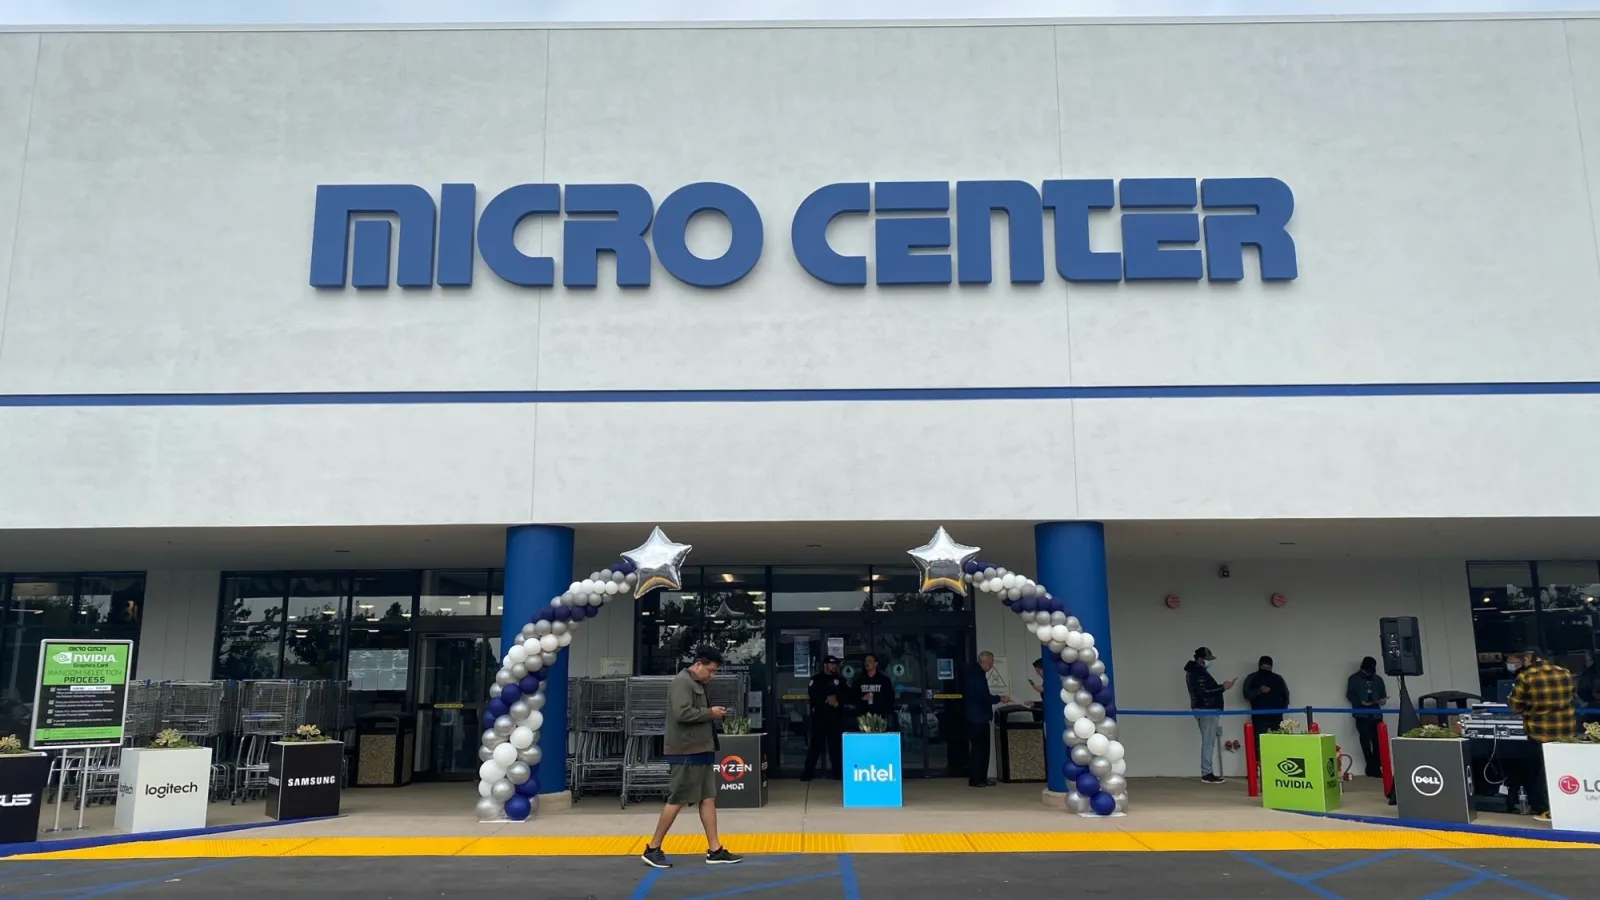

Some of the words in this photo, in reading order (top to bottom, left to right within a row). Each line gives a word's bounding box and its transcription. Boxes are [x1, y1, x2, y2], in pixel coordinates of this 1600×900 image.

[310, 182, 764, 287] MICRO
[792, 178, 1297, 284] CENTER
[73, 654, 116, 663] NVIDIA
[860, 684, 882, 693] SECURITY
[713, 764, 753, 772] RYZEN
[287, 775, 336, 787] SAMSUNG
[1275, 779, 1314, 790] NVIDIA
[1415, 776, 1440, 785] DELL
[145, 781, 198, 799] logitech
[0, 793, 33, 806] US
